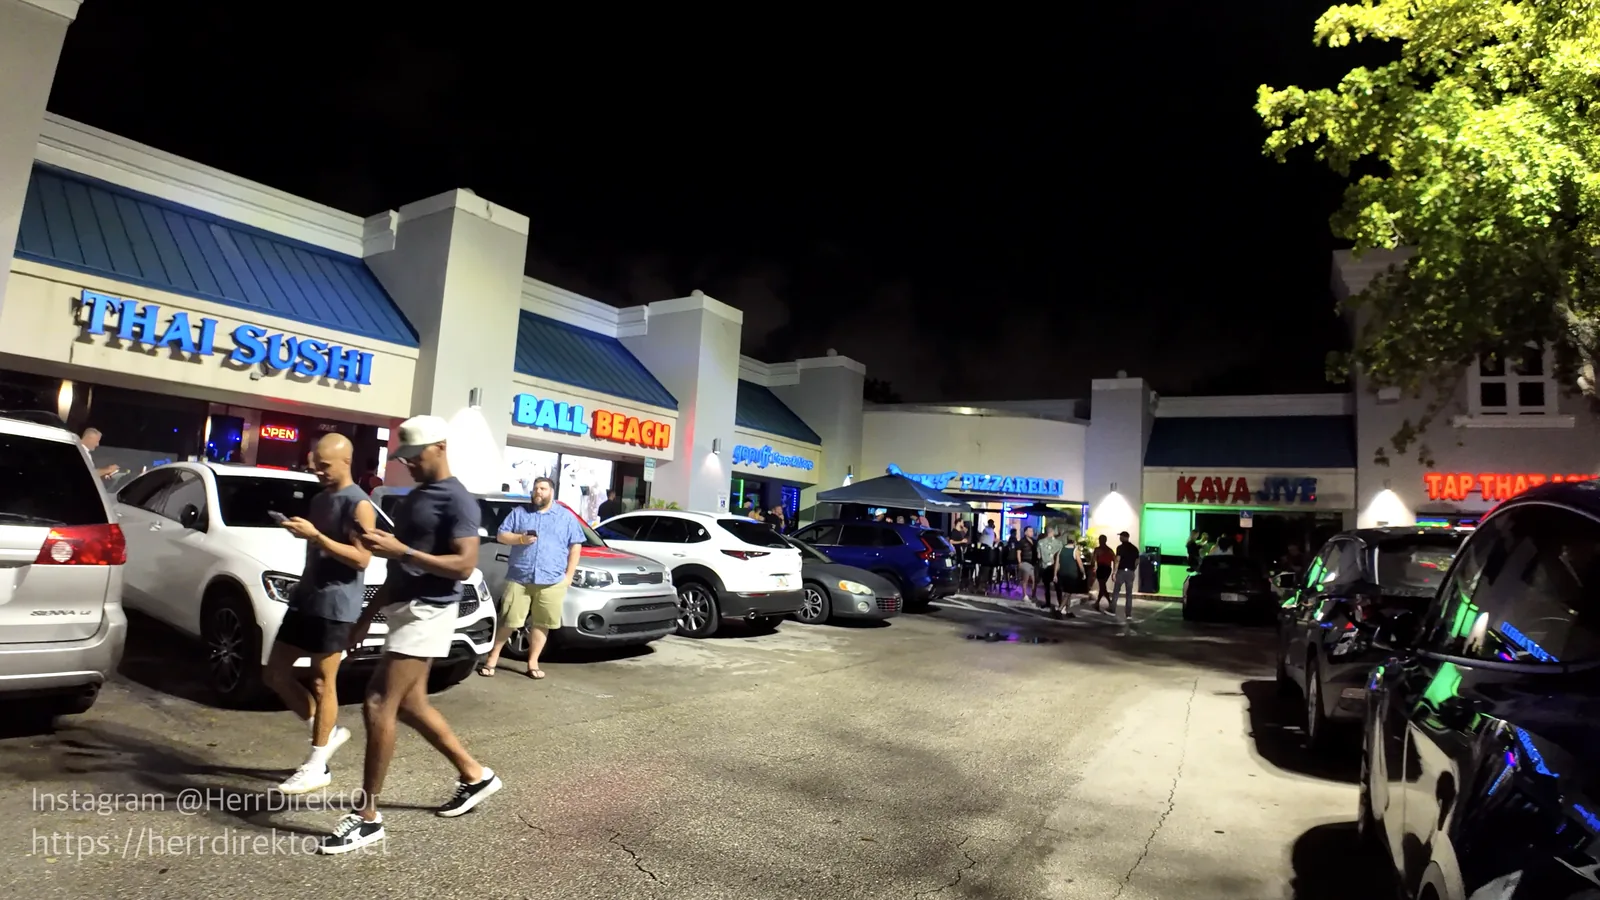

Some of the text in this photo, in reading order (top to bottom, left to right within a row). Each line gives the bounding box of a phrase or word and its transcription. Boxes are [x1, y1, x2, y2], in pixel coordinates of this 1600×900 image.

[81, 289, 374, 385] THAI SUSHI
[261, 427, 296, 441] OPEN
[512, 393, 671, 449] BALL BEACH
[961, 473, 1063, 496] PIZZARELLI
[1177, 476, 1318, 503] KAVA JIVE
[1424, 472, 1475, 500] TAP
